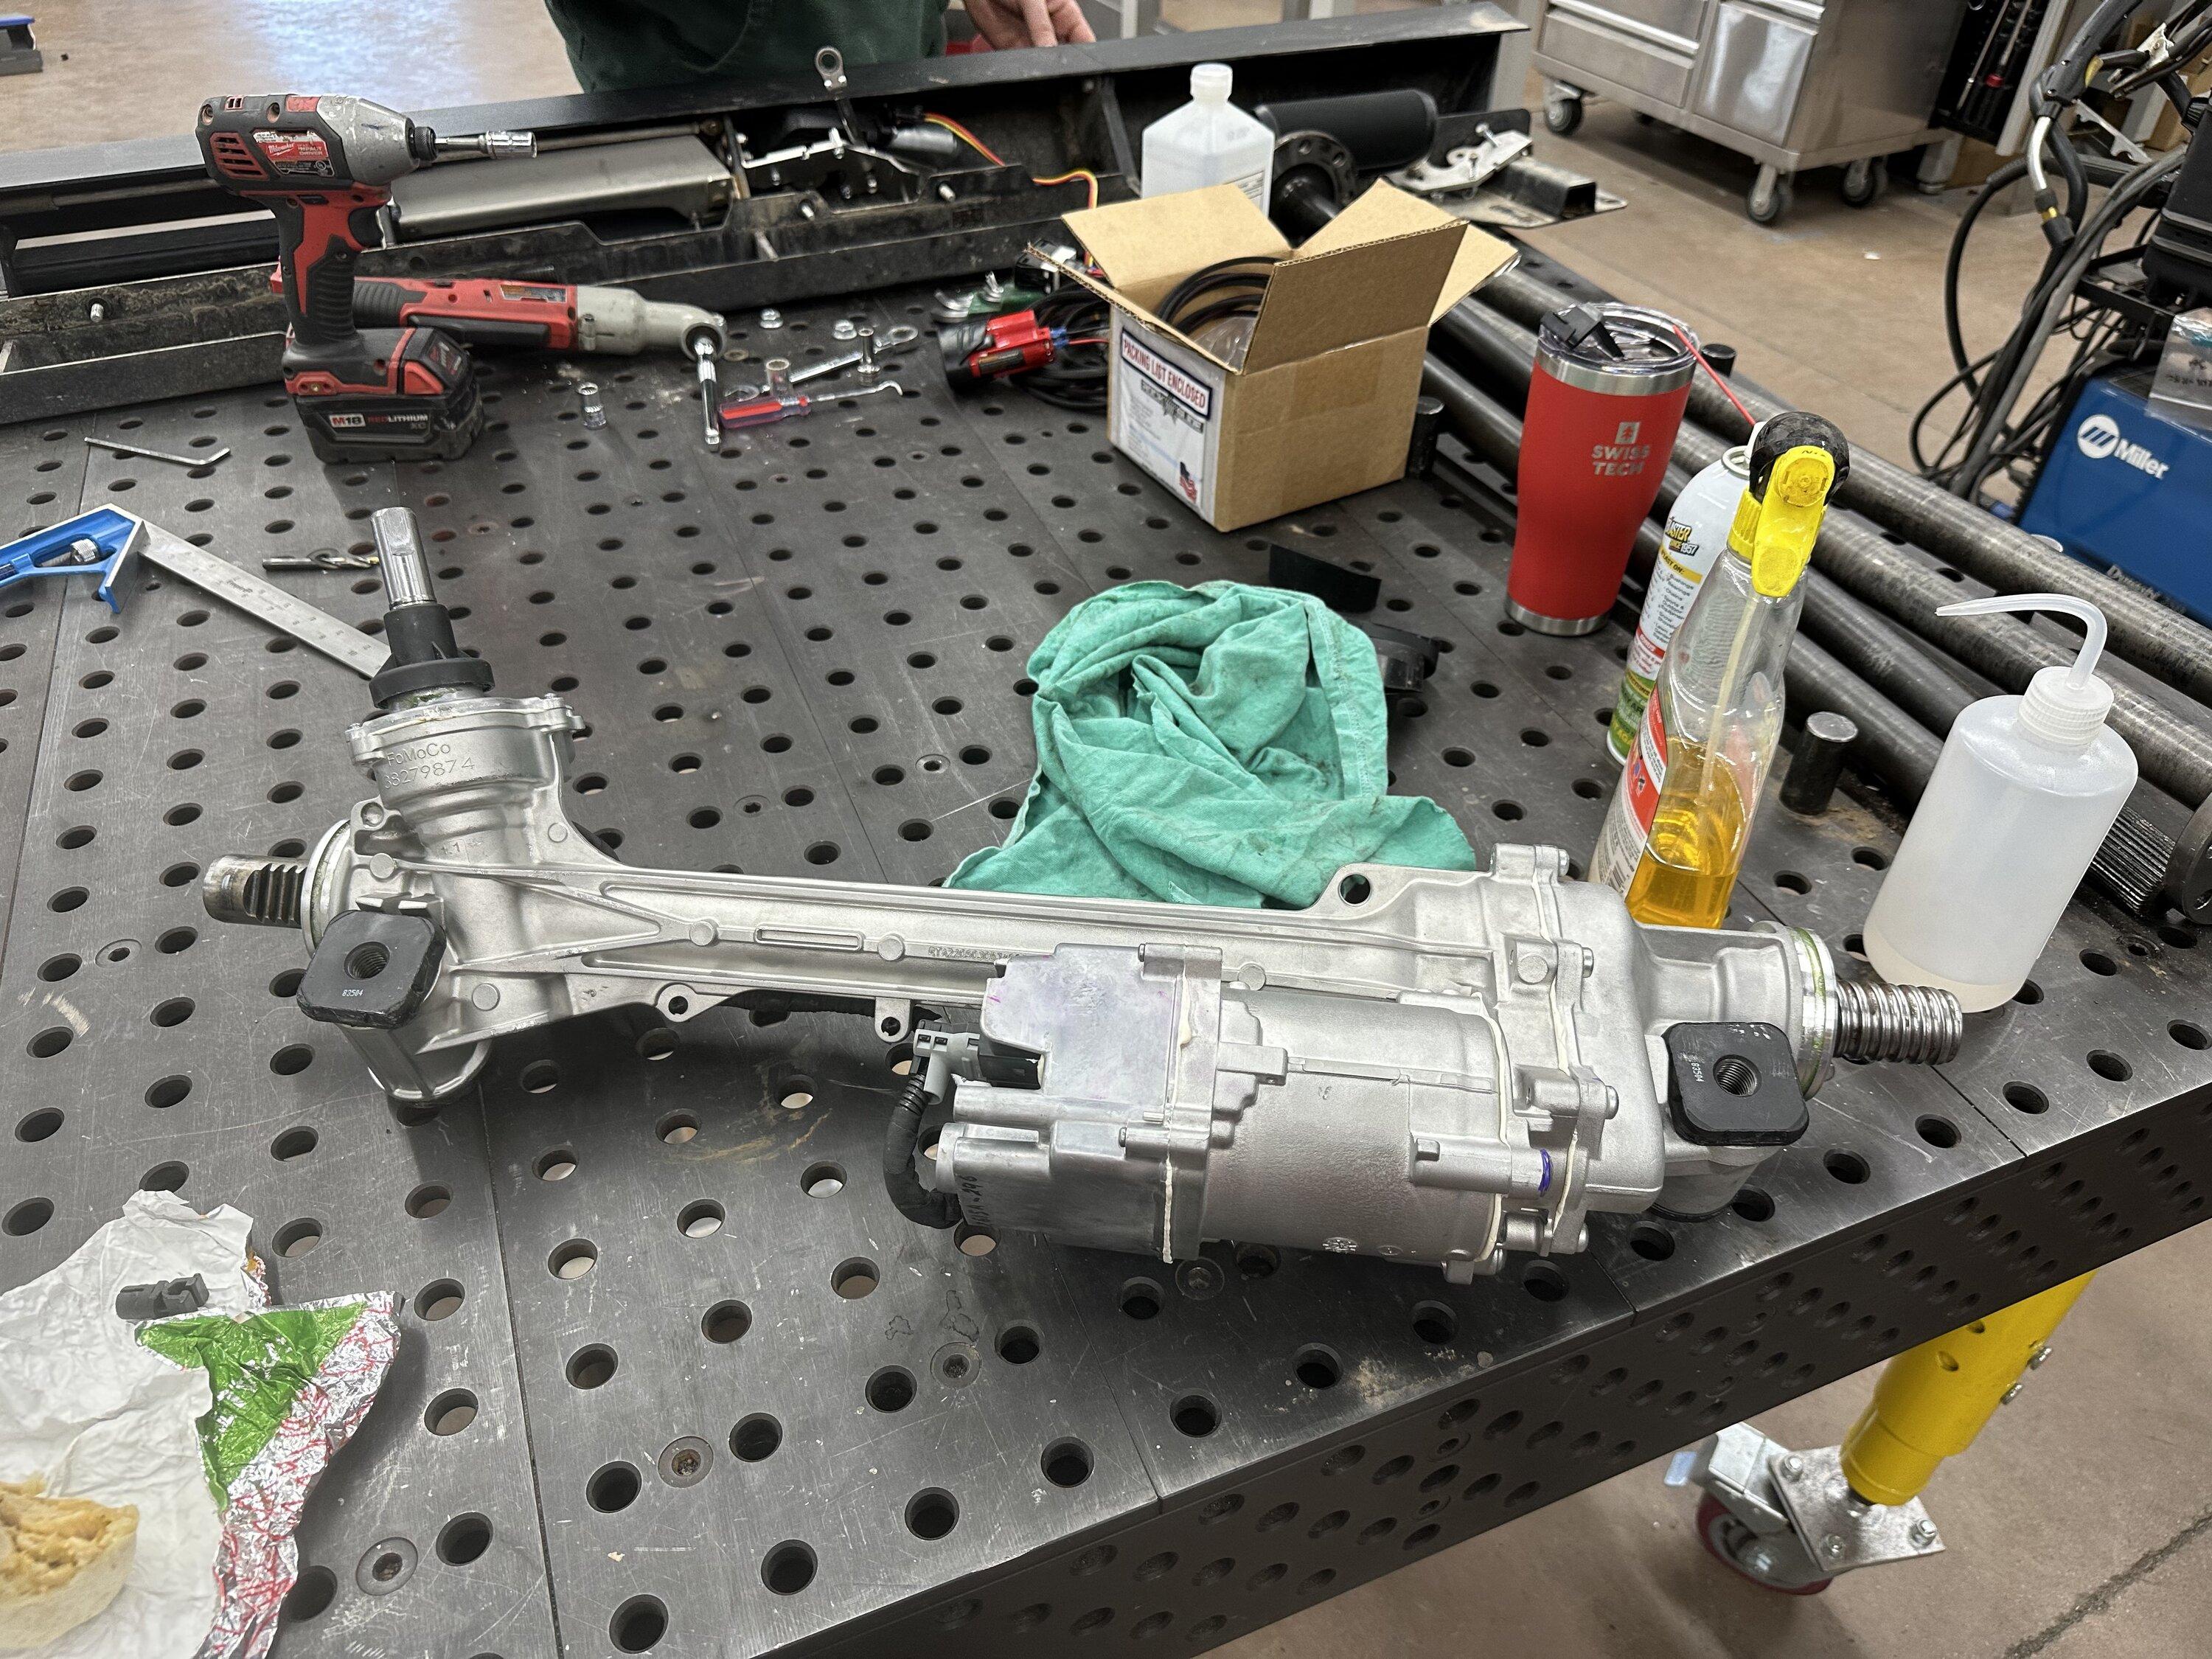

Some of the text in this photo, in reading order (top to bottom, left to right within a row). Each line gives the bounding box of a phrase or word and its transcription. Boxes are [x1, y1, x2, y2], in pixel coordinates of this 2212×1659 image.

[1123, 339, 1151, 371] PACKING
[1151, 358, 1166, 383] LIST
[1167, 370, 1206, 408] ENCLOSED
[332, 416, 362, 426] M18
[1591, 444, 1650, 461] SWISS
[2114, 438, 2170, 479] Miller
[1593, 461, 1645, 476] TECH
[1680, 542, 1699, 556] 1957
[387, 743, 451, 766] FoMoCo
[1691, 1062, 1705, 1082] 83504
